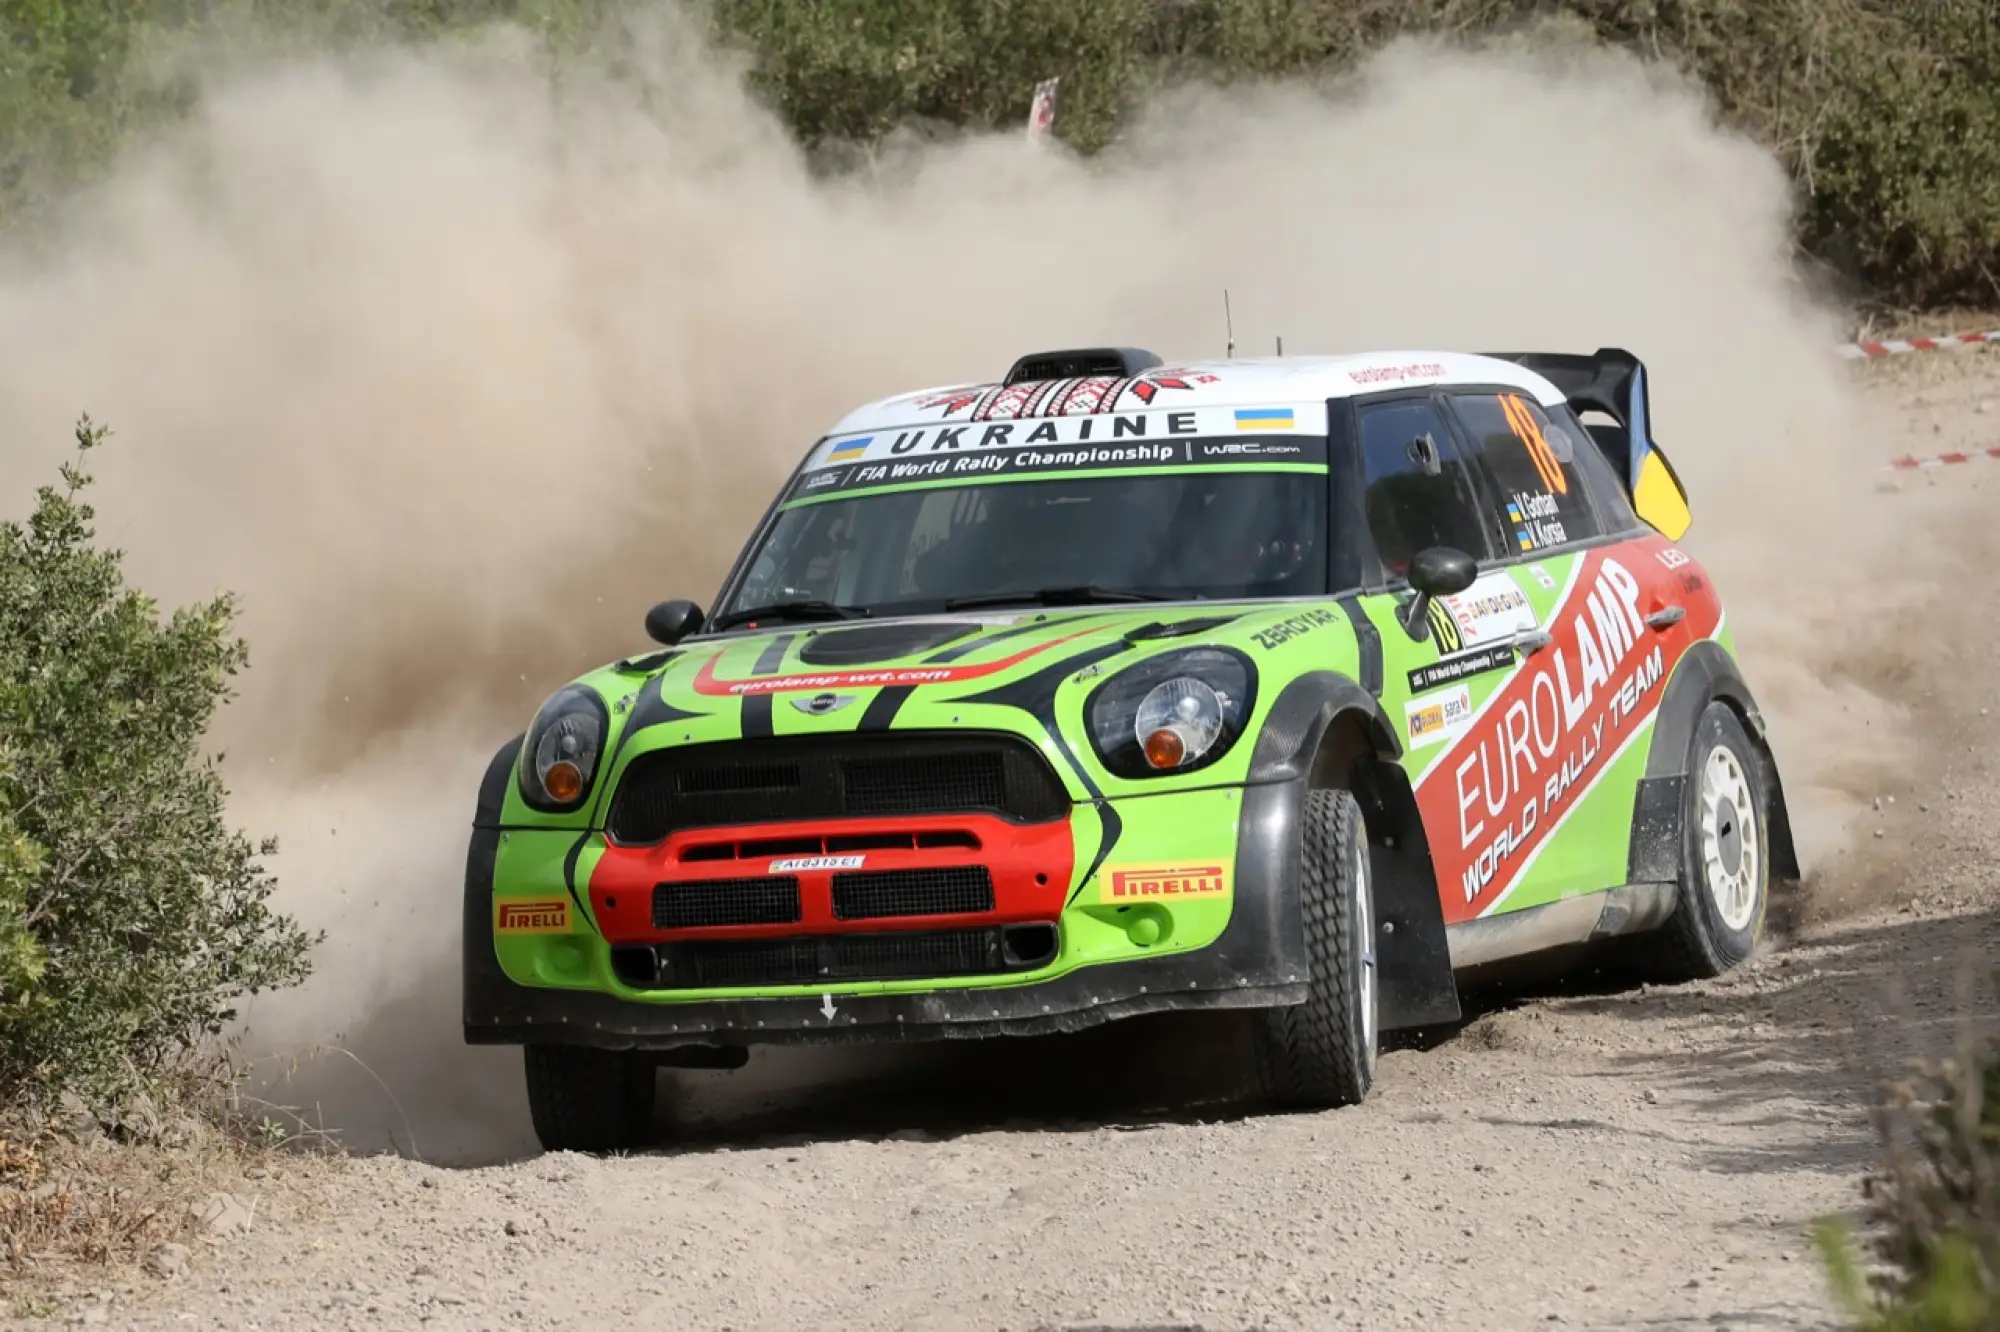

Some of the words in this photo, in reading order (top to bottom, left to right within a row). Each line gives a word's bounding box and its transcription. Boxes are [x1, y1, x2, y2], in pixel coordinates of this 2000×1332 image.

[890, 412, 1198, 454] UKRAINE
[856, 467, 884, 482] FIA
[890, 459, 949, 478] World
[953, 454, 1008, 473] Rally
[1014, 445, 1173, 466] Championship
[729, 670, 952, 693] eurolamp-wrt.com
[1456, 558, 1645, 850] EUROLAMP
[1462, 796, 1539, 903] WORLD
[1544, 714, 1605, 815] RALLY
[1609, 645, 1664, 725] TEAM
[1112, 866, 1223, 897] PIRELLI
[499, 902, 566, 929] PIRELLI
